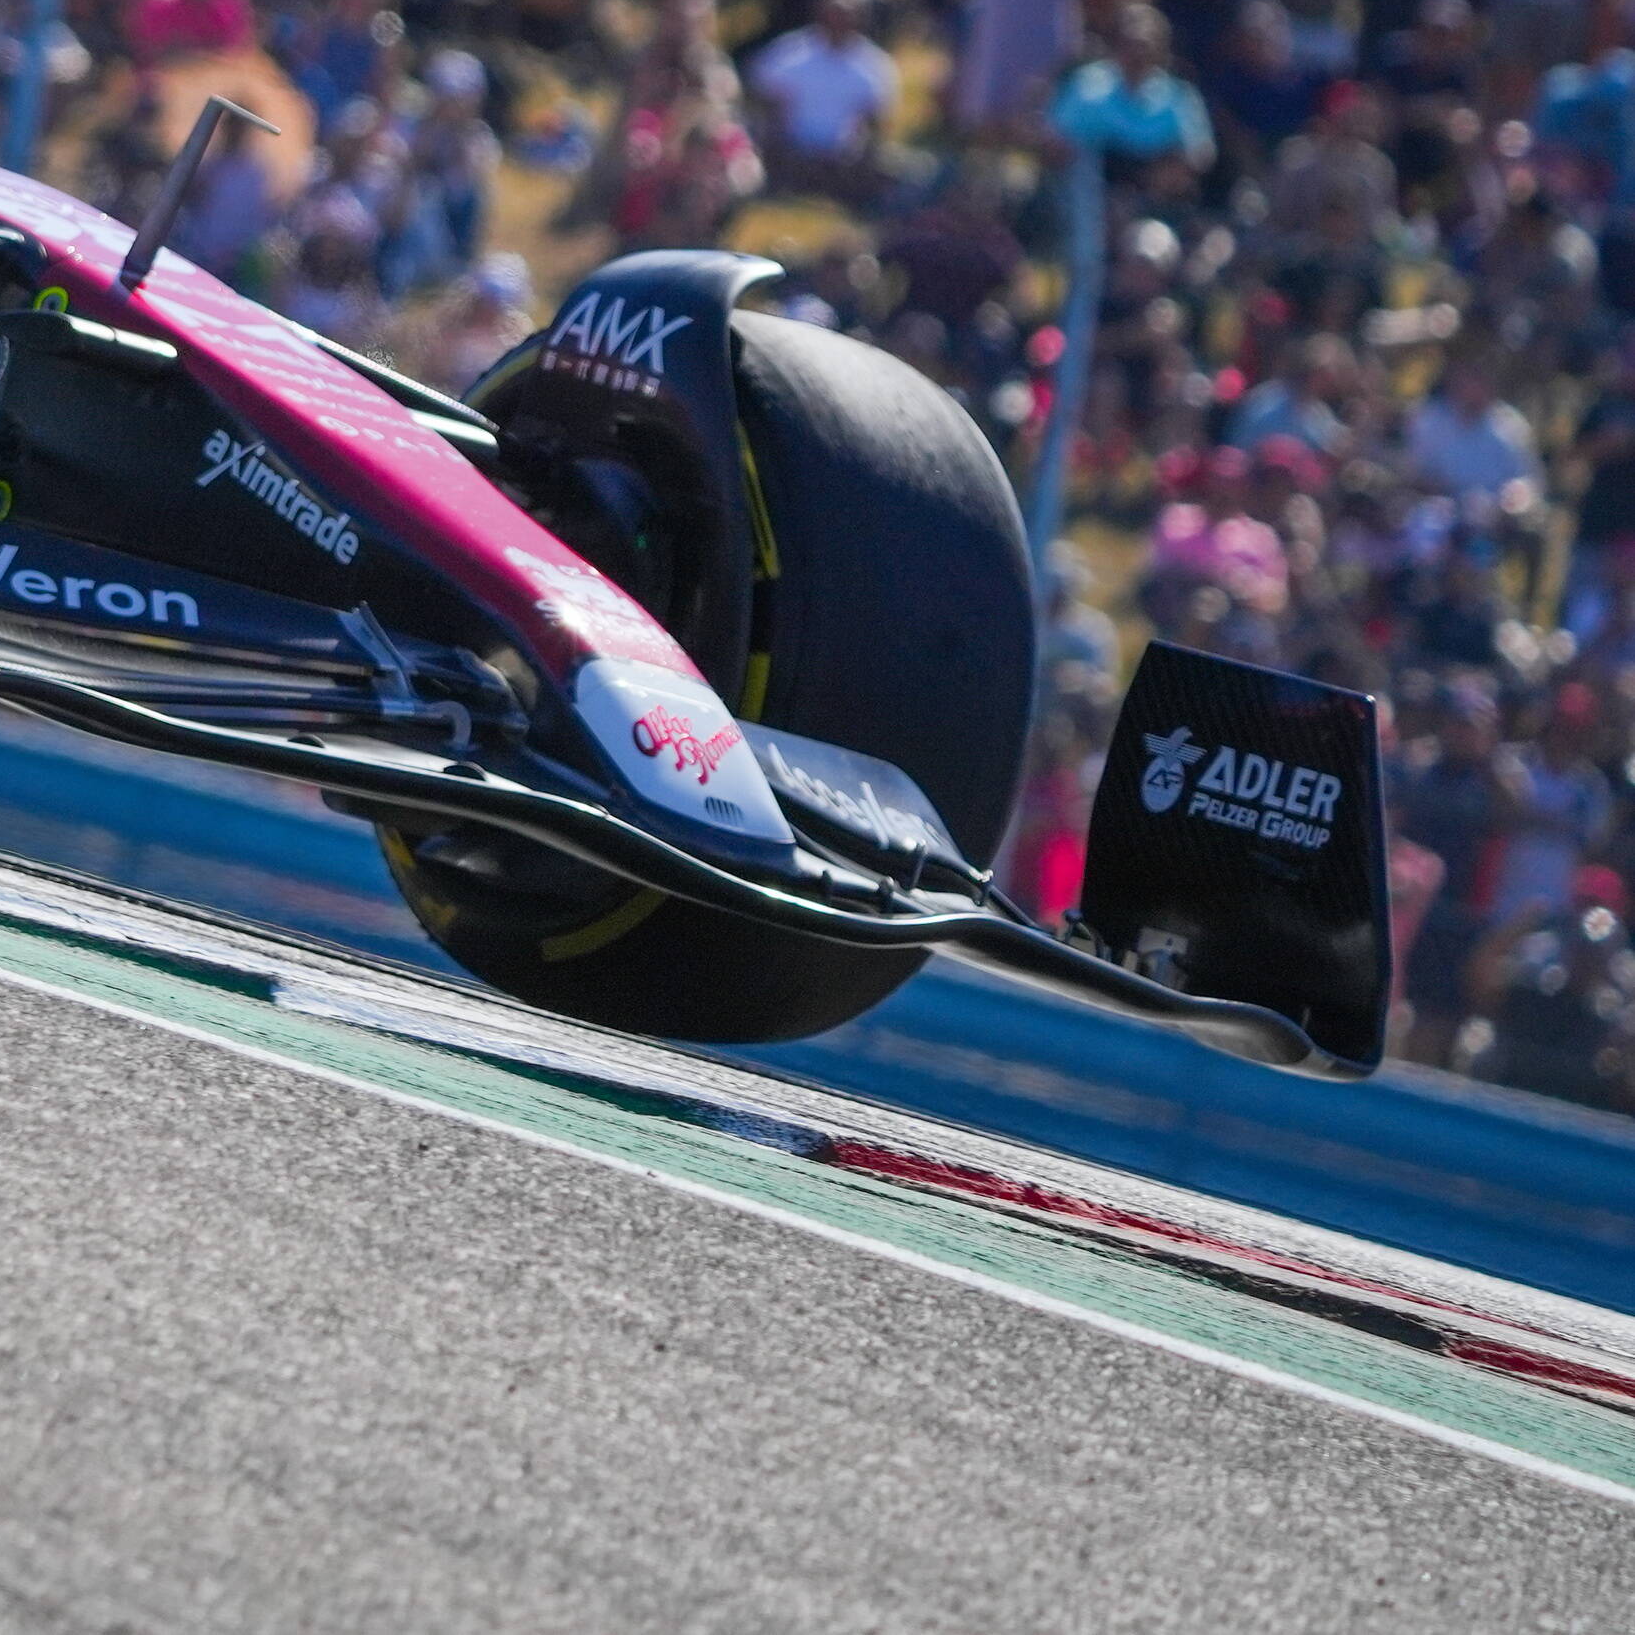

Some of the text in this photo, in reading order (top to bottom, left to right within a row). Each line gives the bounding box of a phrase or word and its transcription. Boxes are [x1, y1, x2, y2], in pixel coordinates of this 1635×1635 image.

[549, 290, 695, 375] AMX
[196, 428, 360, 566] aximtrade
[1197, 745, 1343, 822] ADLER
[1259, 810, 1331, 850] GROUP
